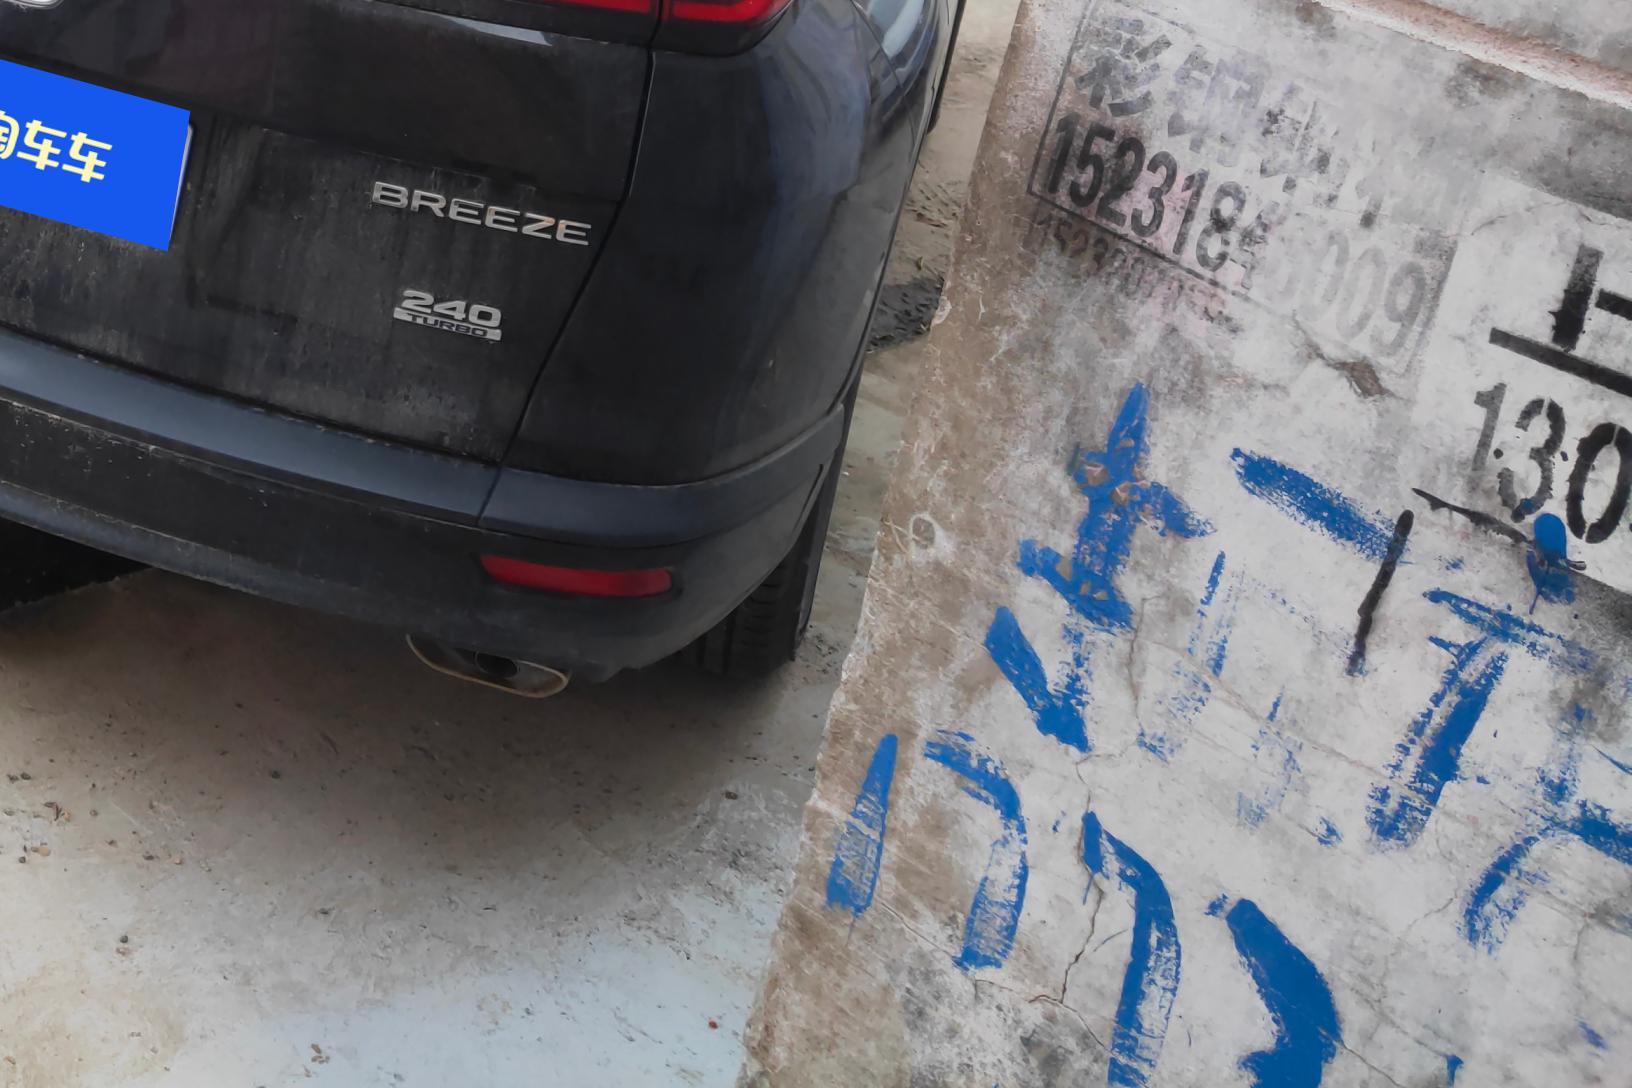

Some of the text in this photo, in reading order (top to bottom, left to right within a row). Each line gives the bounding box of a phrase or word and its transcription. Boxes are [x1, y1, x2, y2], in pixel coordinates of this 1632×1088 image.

[372, 181, 592, 246] BREEZE
[401, 289, 502, 328] 240
[408, 314, 489, 340] TURBO
